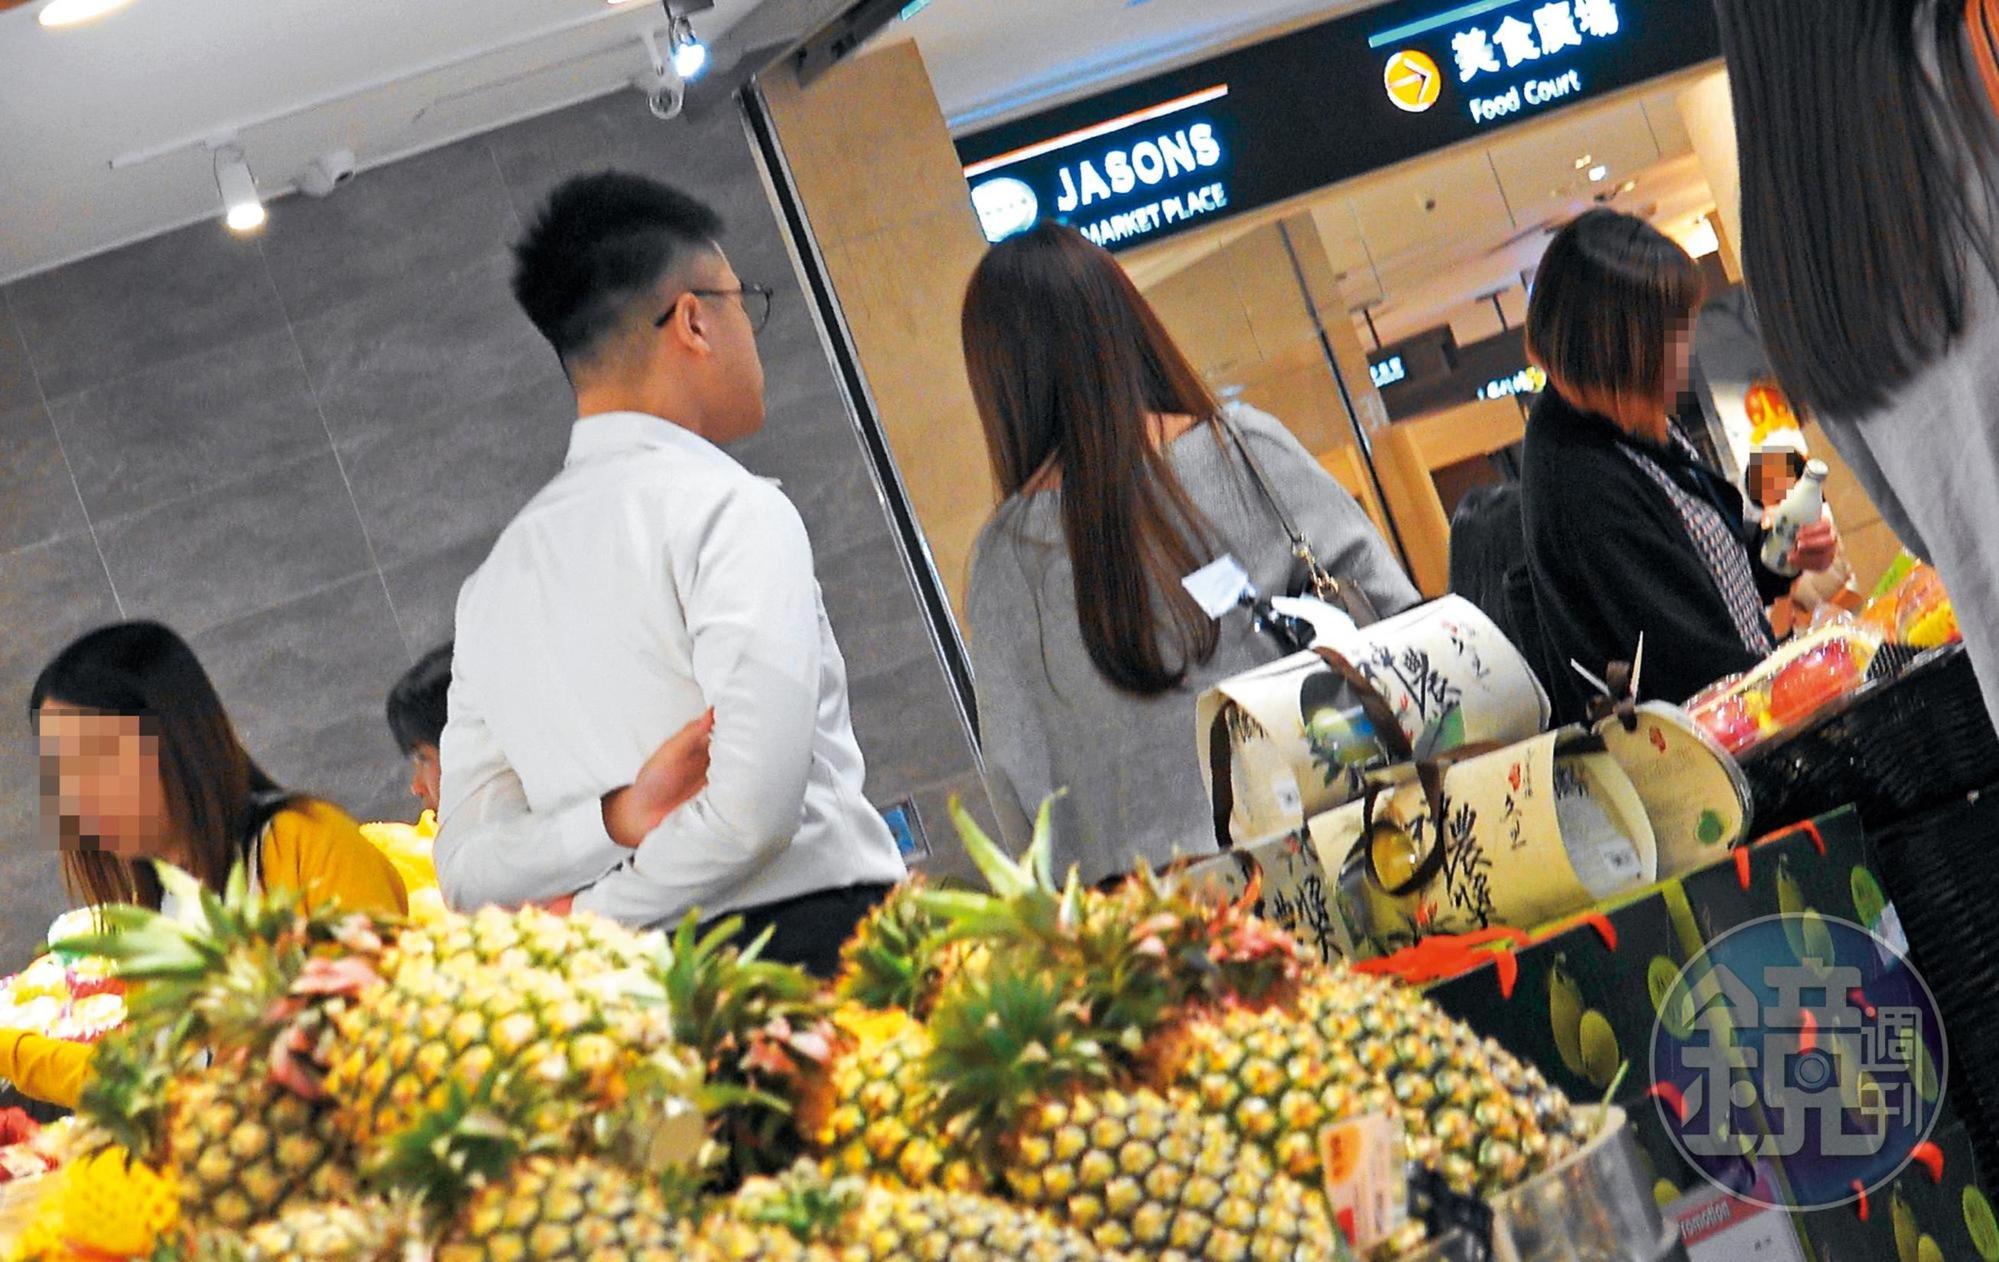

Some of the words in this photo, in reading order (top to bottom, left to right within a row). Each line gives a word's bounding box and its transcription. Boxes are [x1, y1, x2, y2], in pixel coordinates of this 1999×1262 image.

[1451, 0, 1620, 83] 美食廣場
[1469, 86, 1521, 123] Food
[1524, 69, 1581, 105] Court
[1057, 123, 1220, 212] JASONS
[1080, 202, 1160, 247] MARKET
[1161, 182, 1227, 223] PLACE
